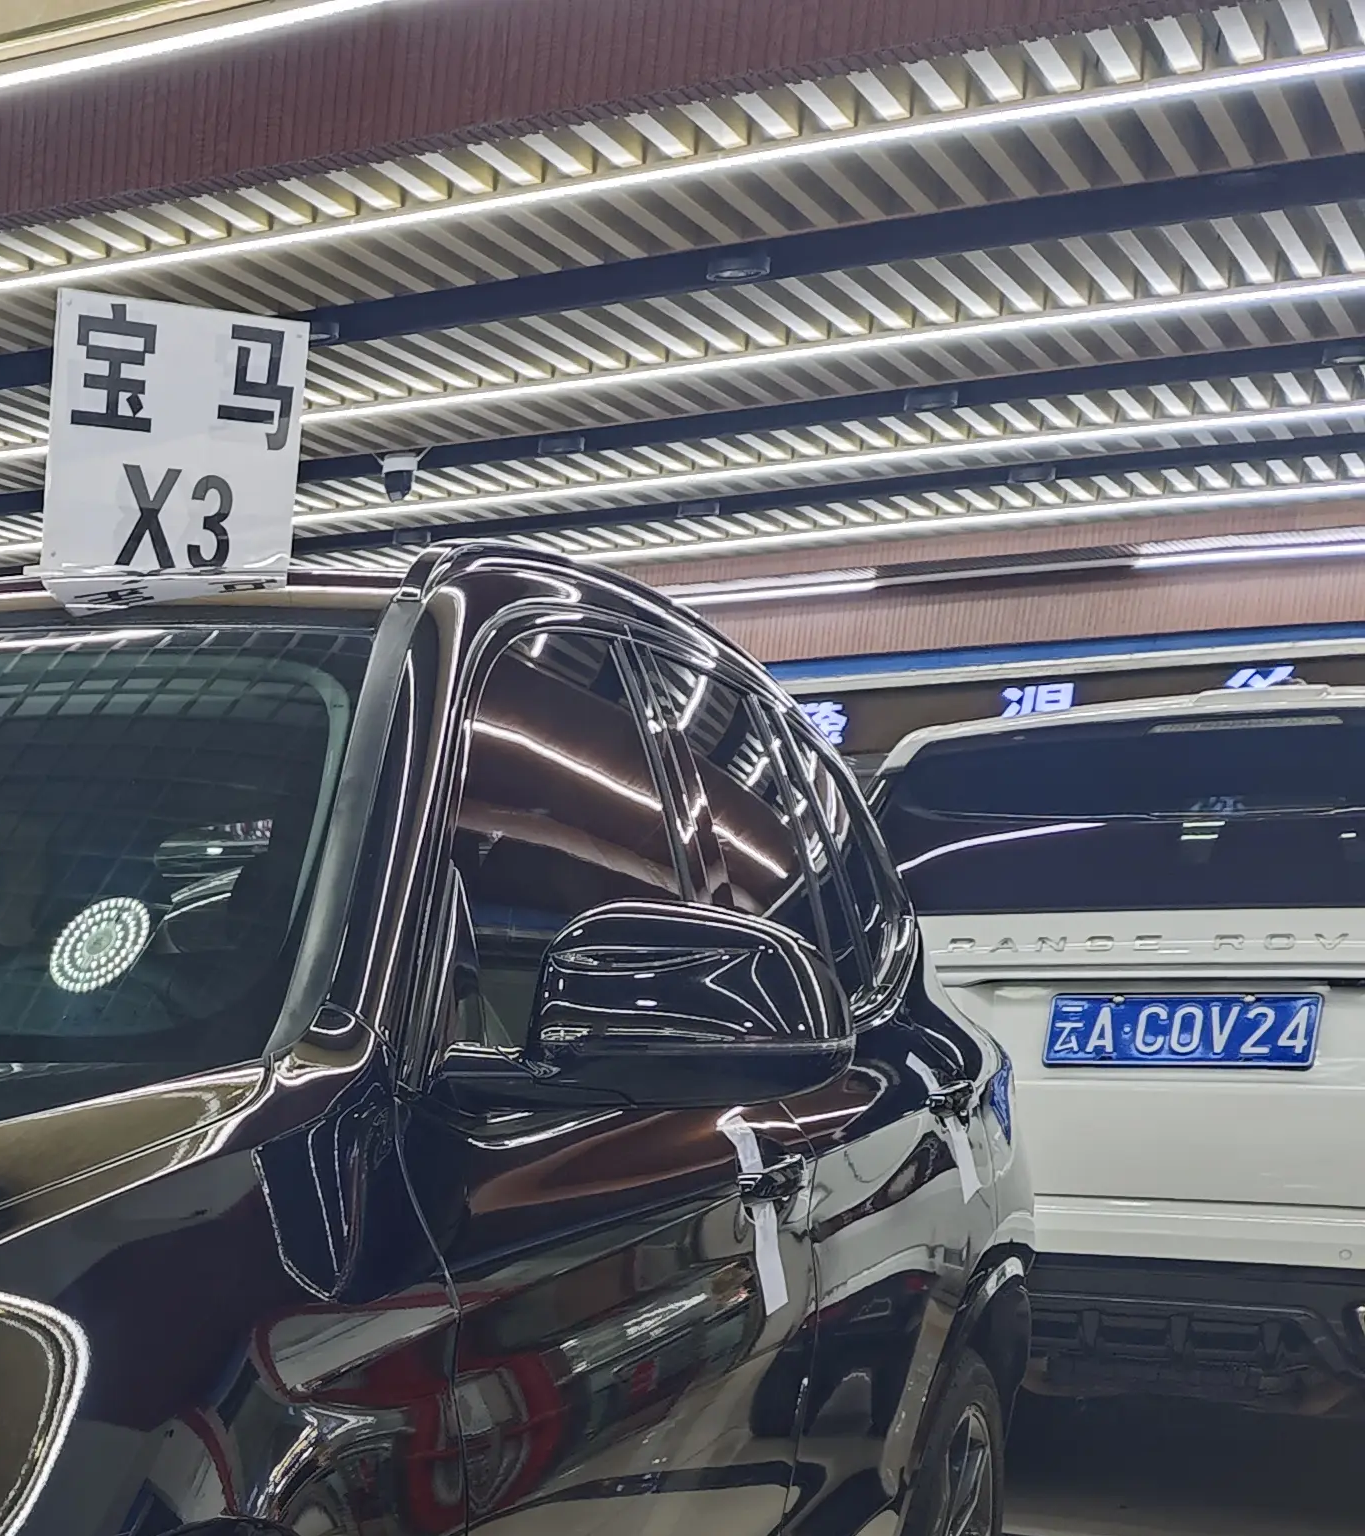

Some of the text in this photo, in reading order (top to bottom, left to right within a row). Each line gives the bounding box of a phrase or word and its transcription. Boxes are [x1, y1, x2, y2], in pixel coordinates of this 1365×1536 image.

[70, 303, 295, 451] 宝马
[114, 463, 234, 569] X3
[947, 934, 1163, 953] RANGE
